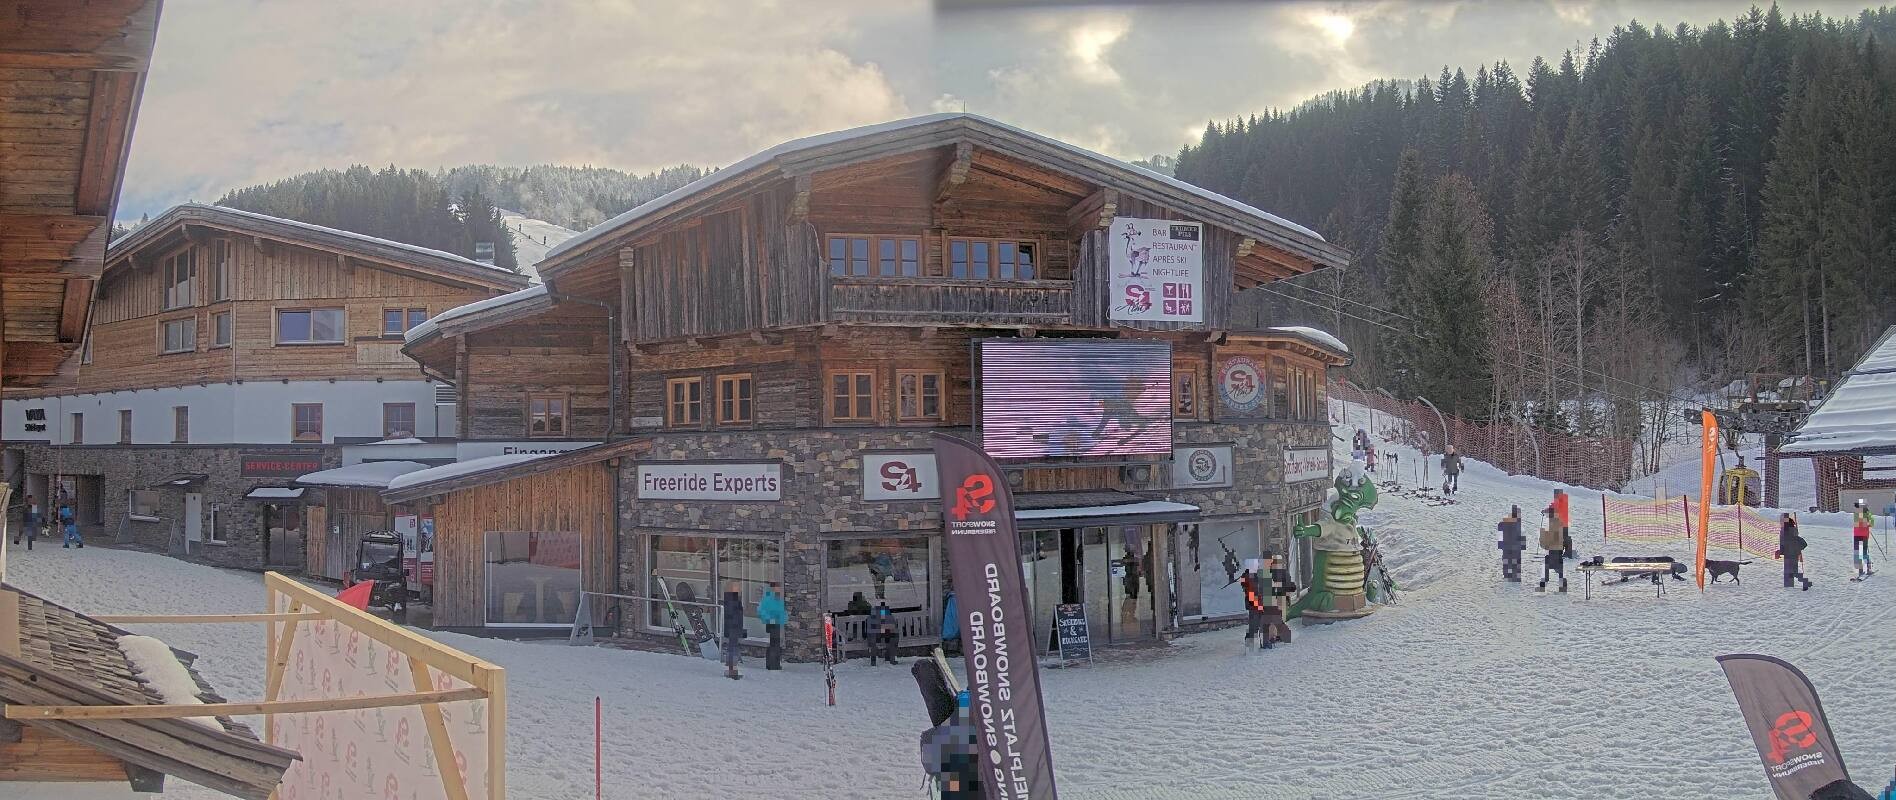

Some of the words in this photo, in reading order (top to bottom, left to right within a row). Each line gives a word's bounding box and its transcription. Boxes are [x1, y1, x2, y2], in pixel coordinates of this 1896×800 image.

[1152, 228, 1167, 237] BAR
[1152, 242, 1198, 251] RESTAURANT
[1176, 256, 1187, 264] SKI
[1152, 268, 1189, 278] NIGHTLIFE
[644, 473, 707, 491] Freeride
[713, 472, 777, 494] Experts
